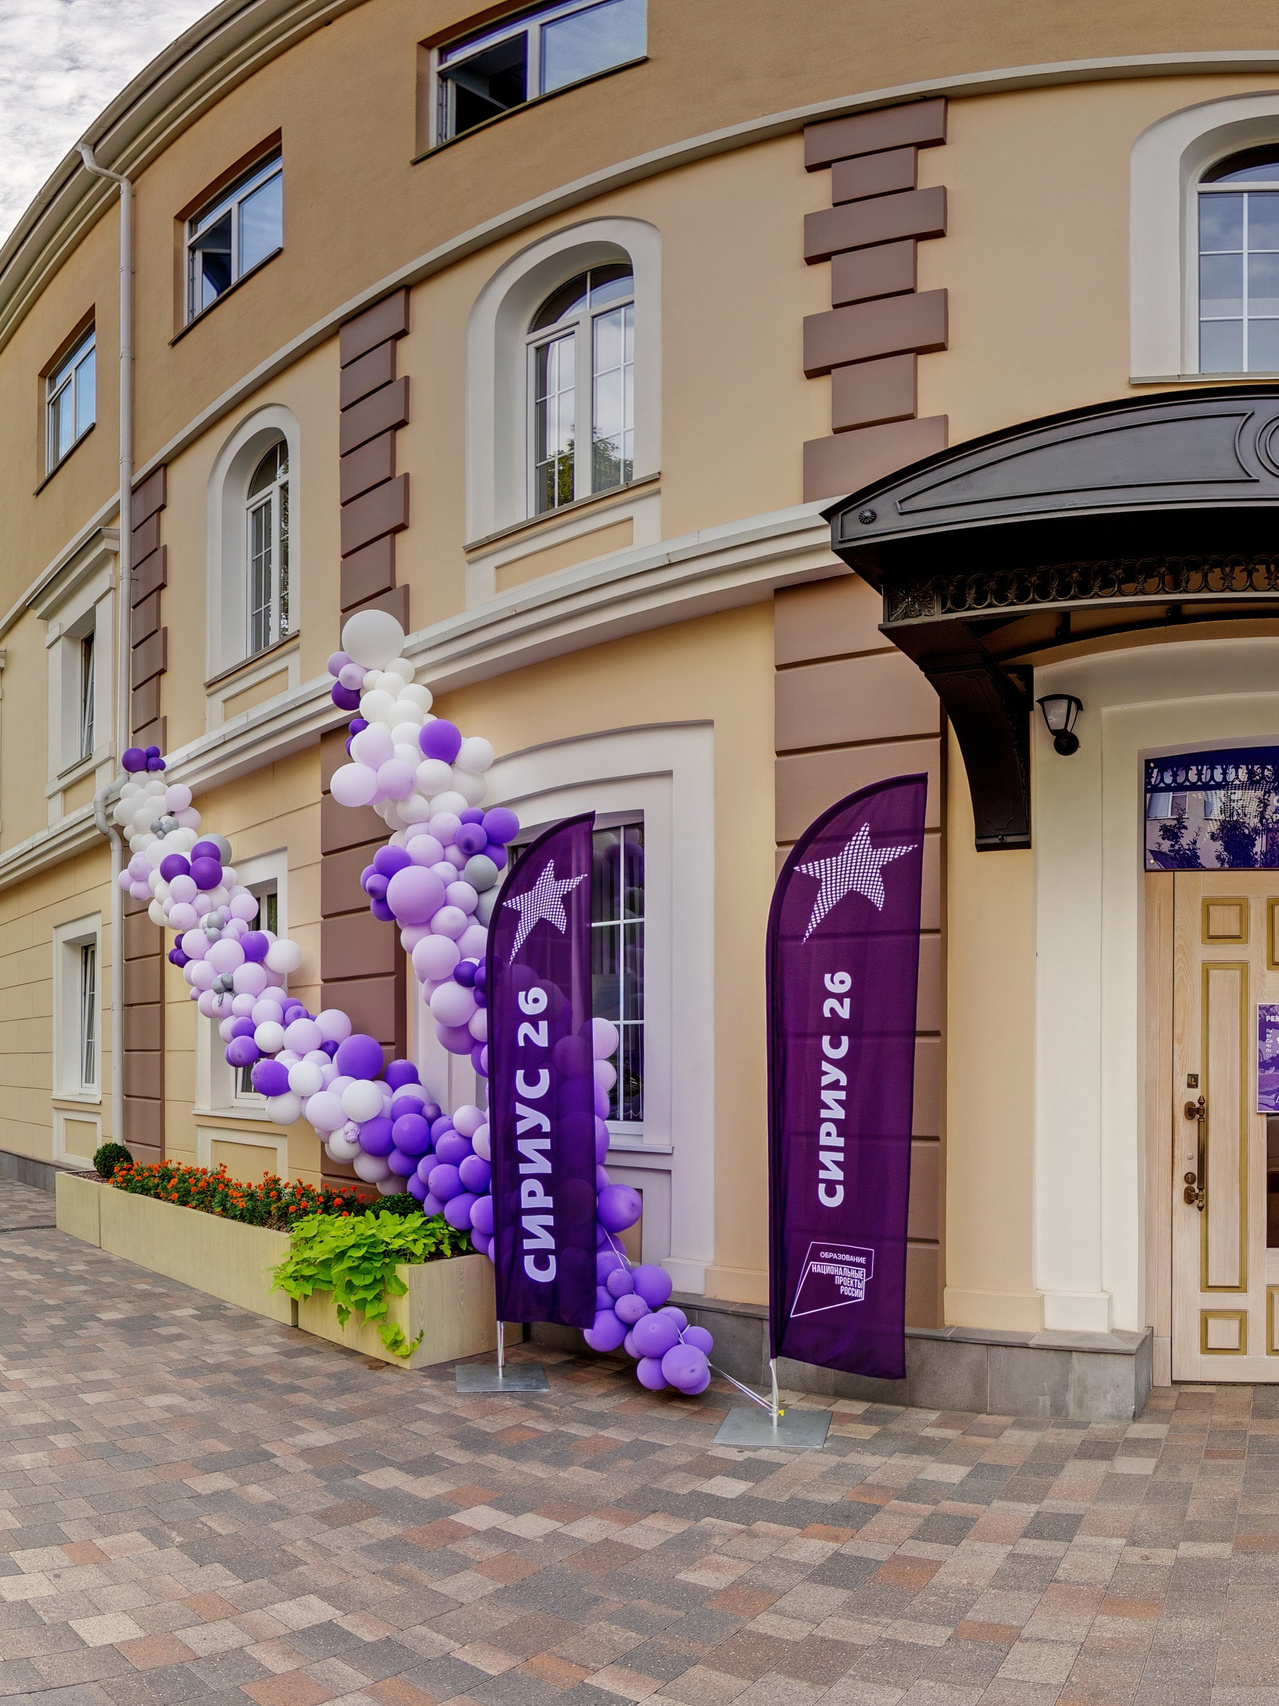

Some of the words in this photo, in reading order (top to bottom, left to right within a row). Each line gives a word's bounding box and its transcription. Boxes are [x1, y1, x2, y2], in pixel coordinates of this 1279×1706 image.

[823, 971, 852, 1019] 26
[517, 987, 548, 1047] 26
[818, 1035, 849, 1208] СИРИУС
[515, 1068, 557, 1283] СИРИУС
[811, 1264, 864, 1280] НАЦИОНАЛЬНЫЕ
[820, 1251, 867, 1264] ОБРАЗОВАНИЕ
[834, 1275, 864, 1289] ПРОЕКТЫ
[840, 1285, 863, 1299] РОССИИ
